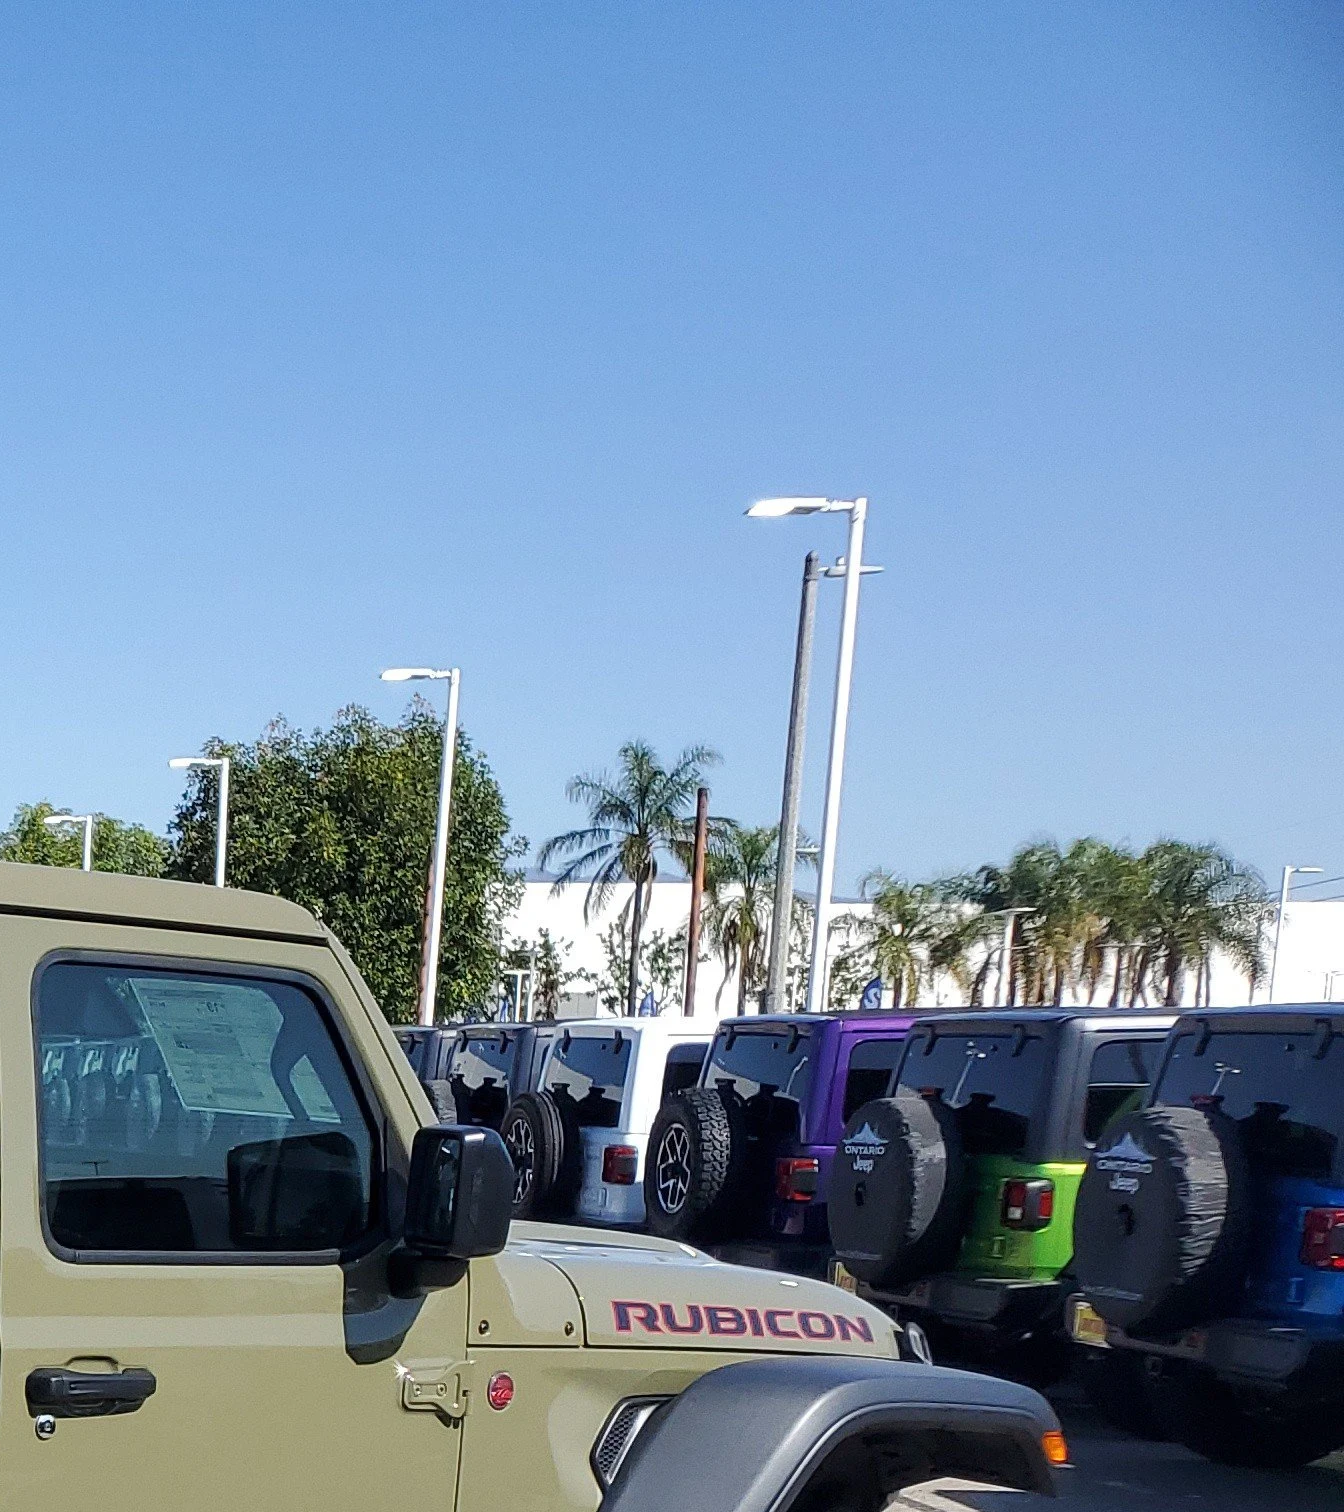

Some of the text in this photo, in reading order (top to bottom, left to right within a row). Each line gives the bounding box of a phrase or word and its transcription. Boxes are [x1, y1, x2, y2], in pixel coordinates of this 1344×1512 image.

[844, 1145, 885, 1155] ONTARIO
[853, 1155, 874, 1174] Jeep
[610, 1300, 875, 1343] RUBICON
